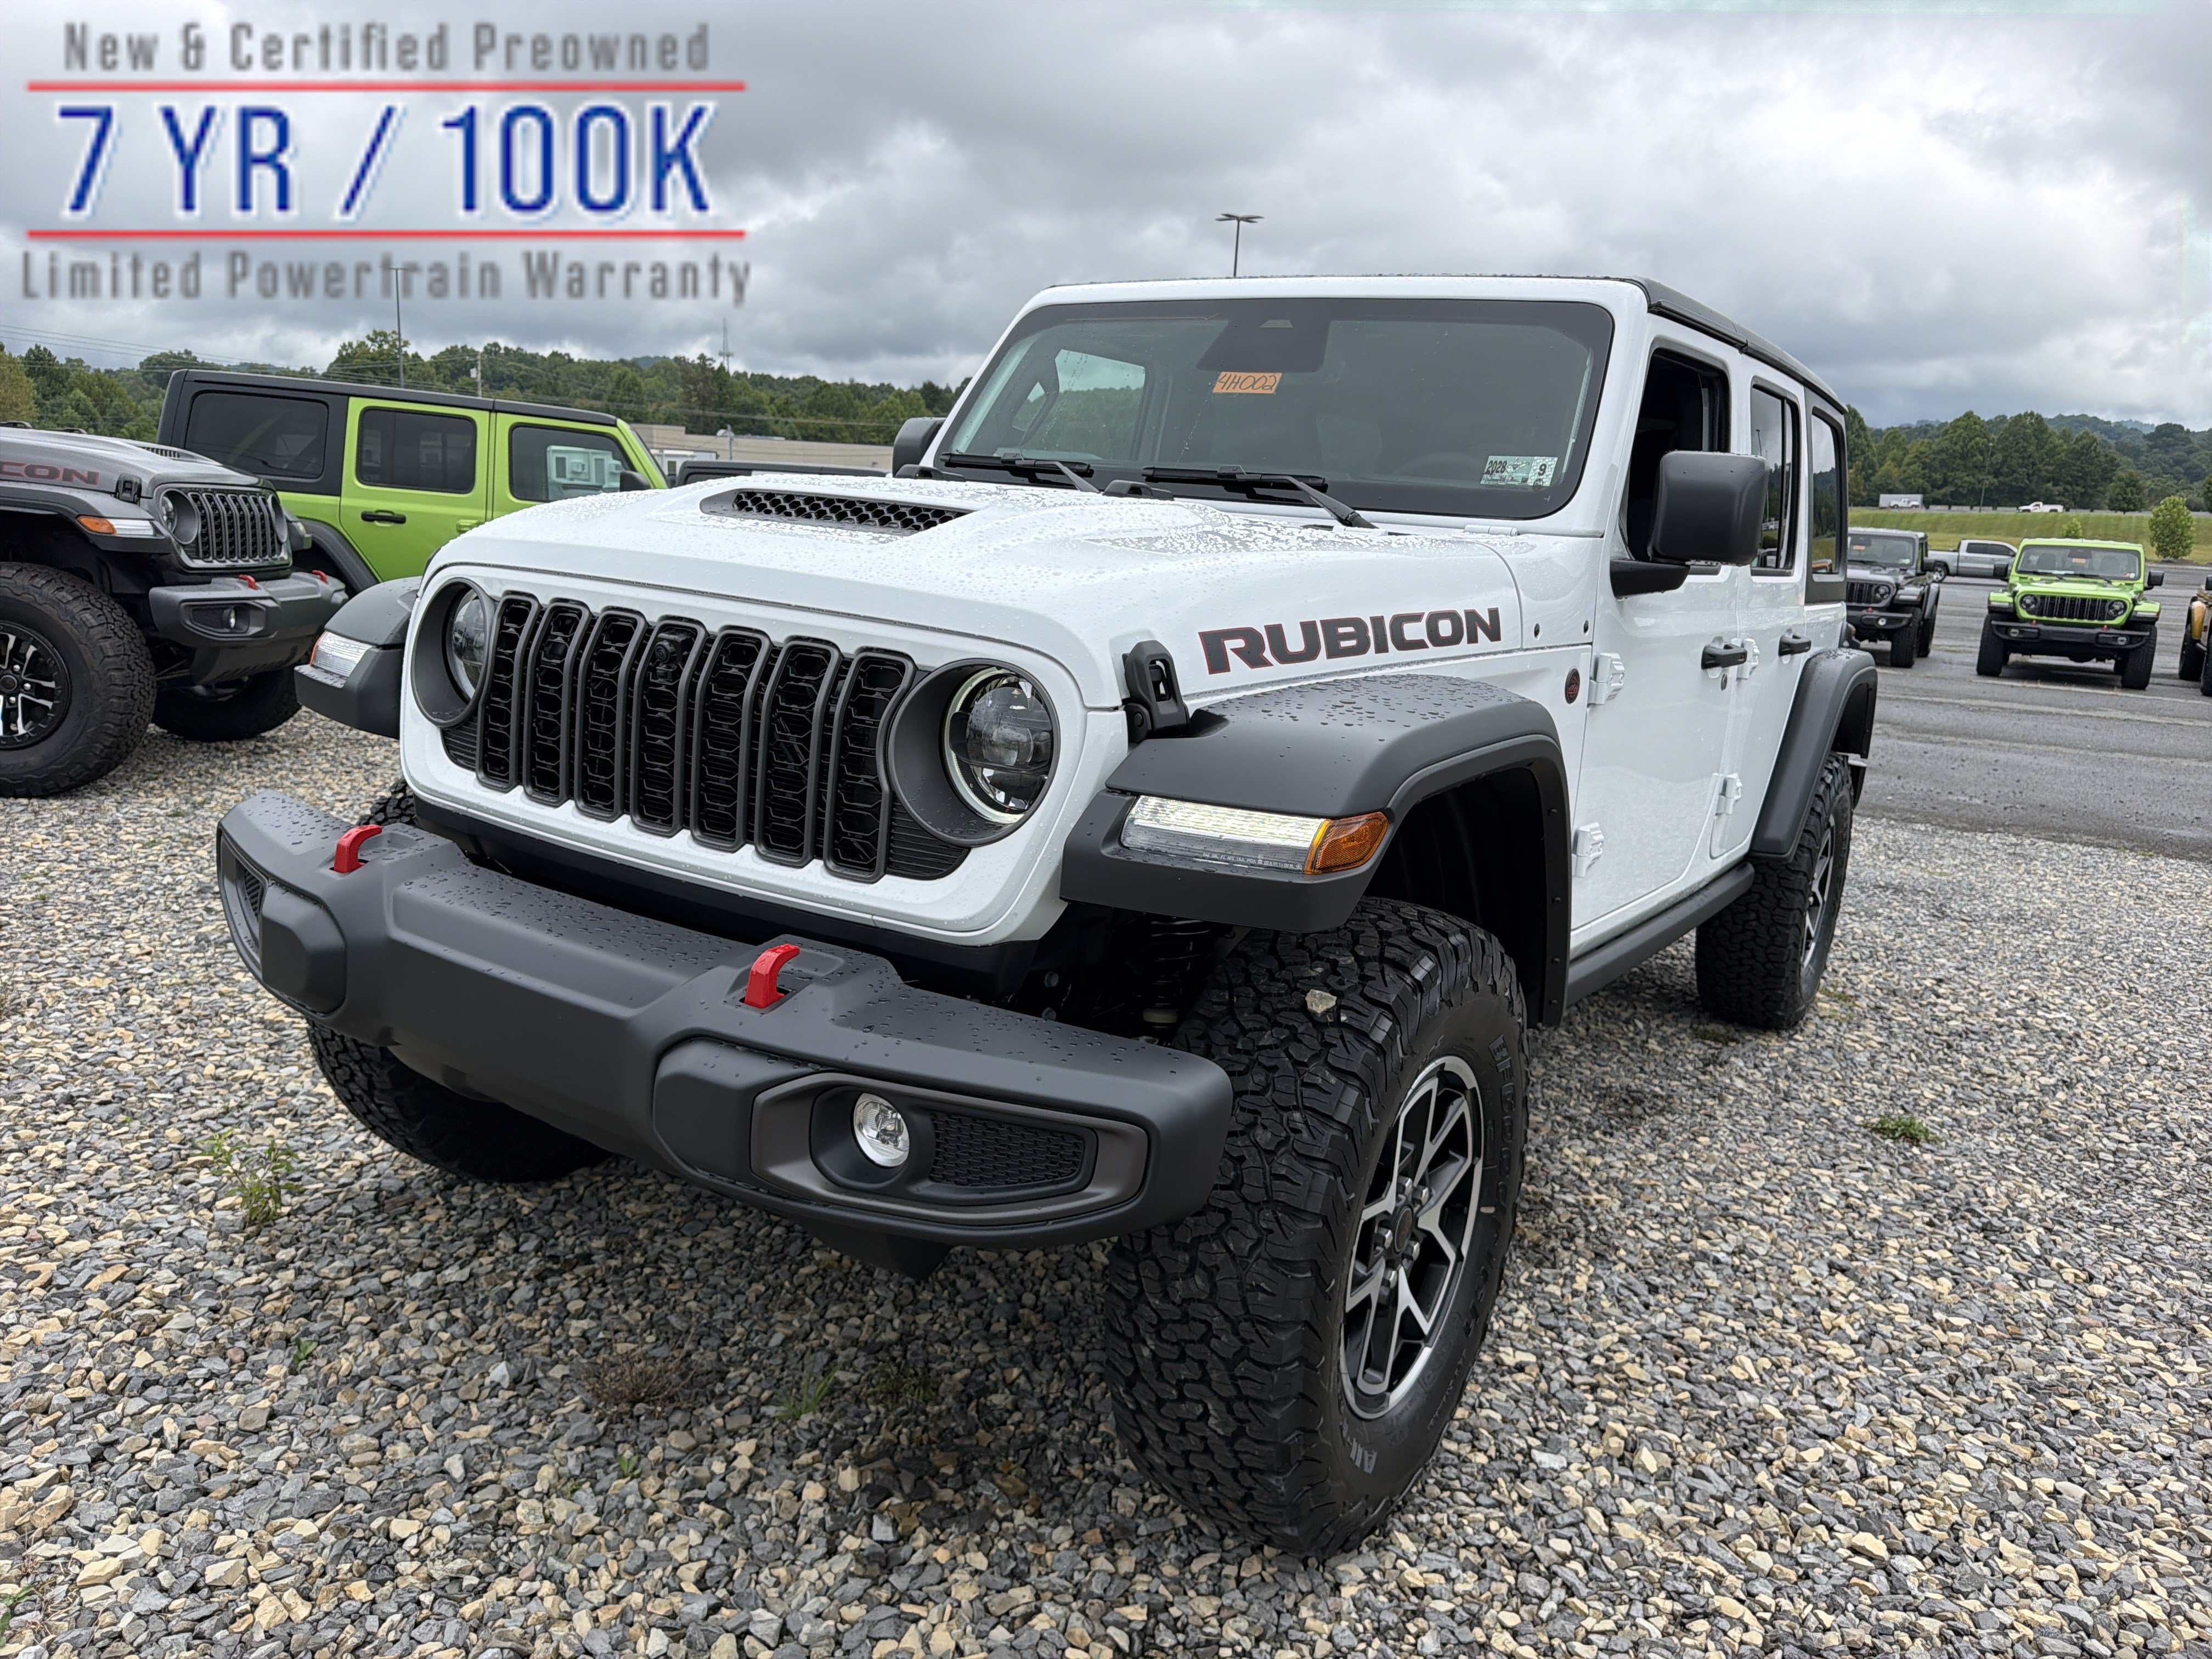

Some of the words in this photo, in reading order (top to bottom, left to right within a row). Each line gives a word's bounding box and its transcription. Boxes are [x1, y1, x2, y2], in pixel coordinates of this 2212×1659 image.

[1482, 460, 1507, 475] 2028
[1538, 463, 1547, 476] 9
[1198, 607, 1501, 675] RUBICON
